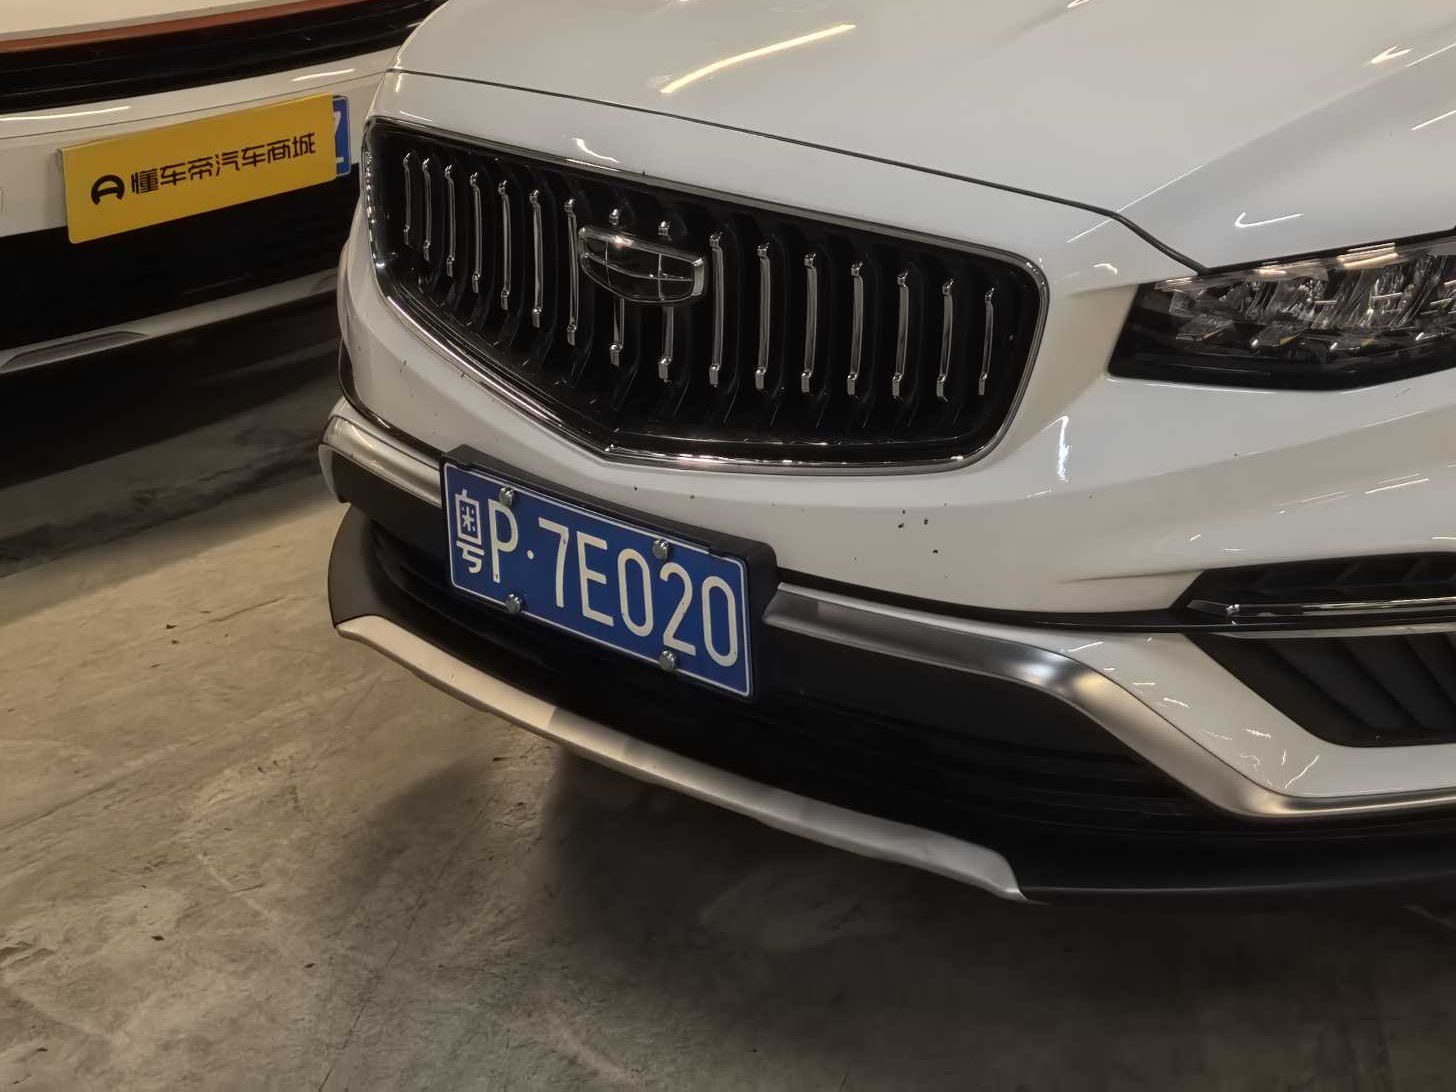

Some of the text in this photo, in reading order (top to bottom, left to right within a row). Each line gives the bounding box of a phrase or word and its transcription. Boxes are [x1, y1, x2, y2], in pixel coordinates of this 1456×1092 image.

[129, 131, 317, 196] 懂车帝汽车商城
